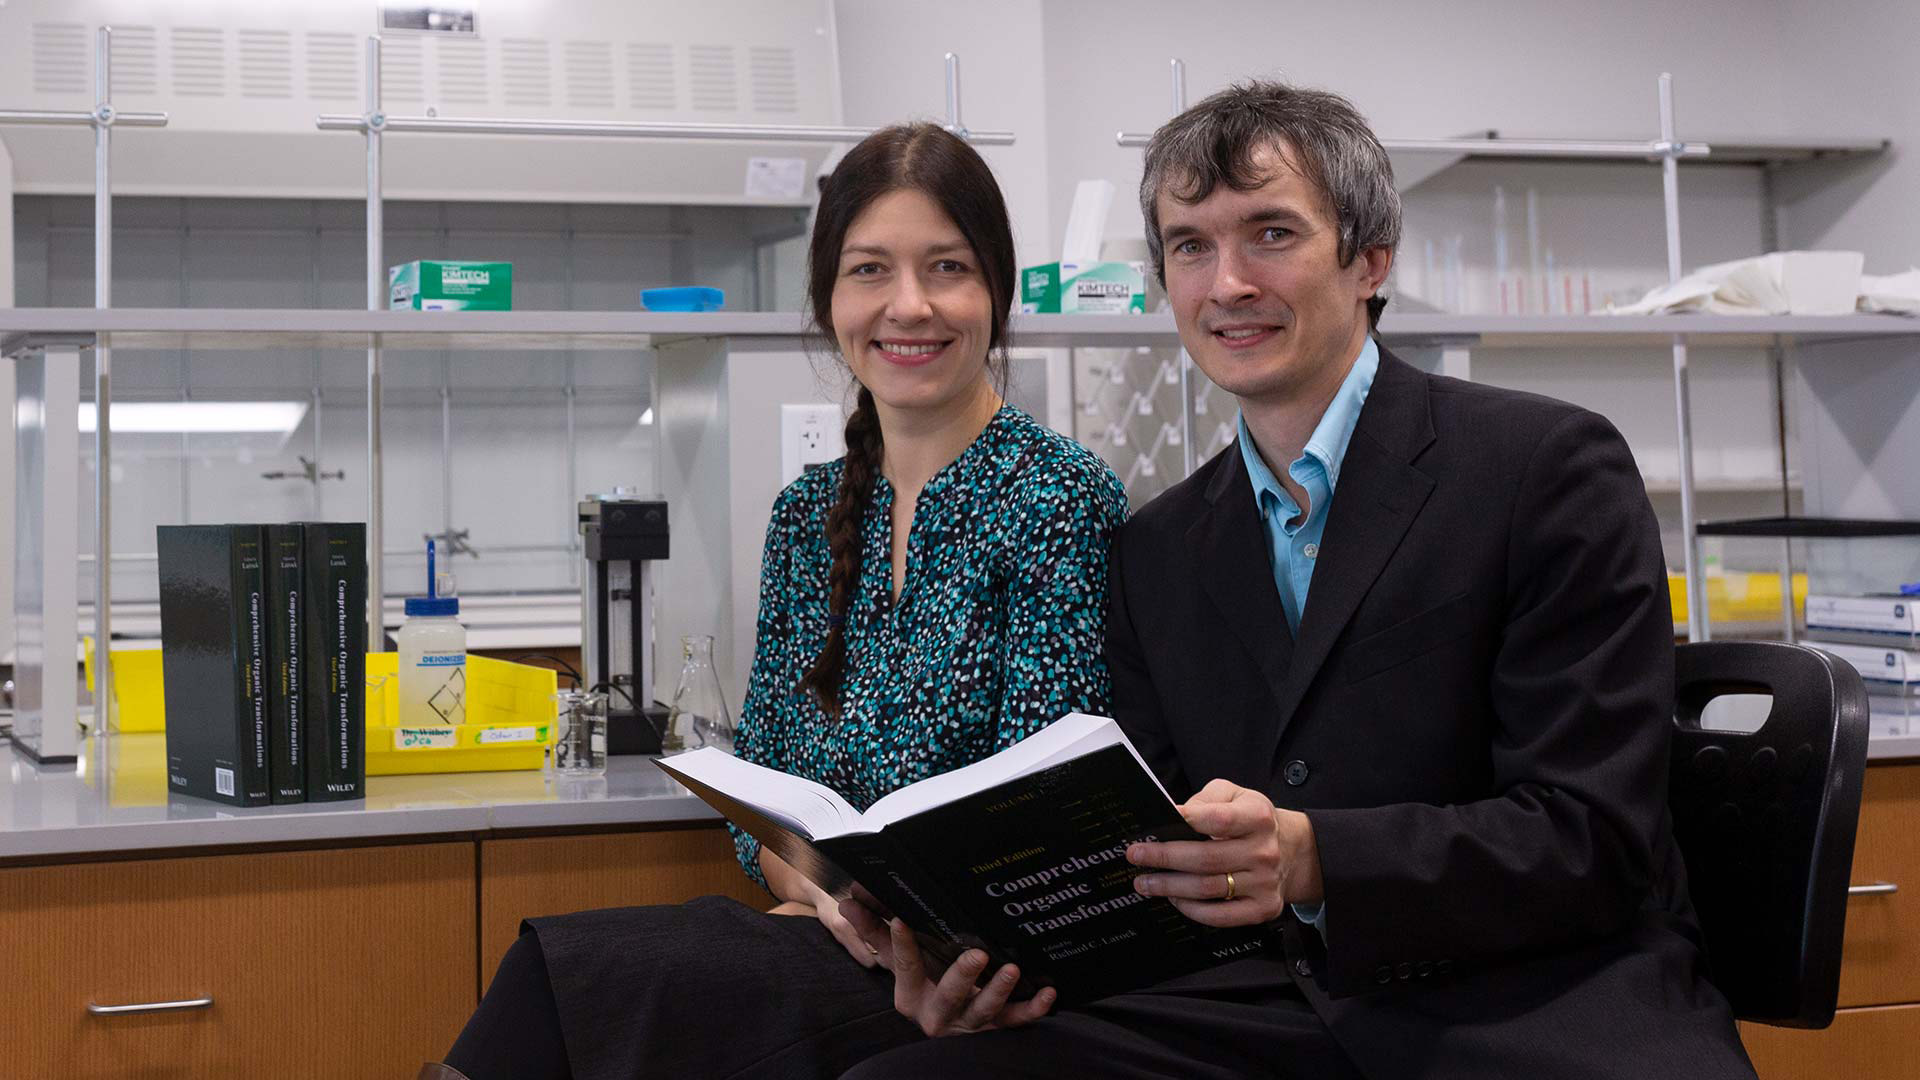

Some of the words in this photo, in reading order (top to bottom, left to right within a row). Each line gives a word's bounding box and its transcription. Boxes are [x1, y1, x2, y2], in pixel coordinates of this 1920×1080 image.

[442, 270, 490, 280] KIMTECH
[1078, 284, 1129, 294] KIMTECH
[250, 592, 260, 656] Comprehensive
[288, 591, 298, 654] Comprehensive
[337, 580, 347, 649] Comprehensive
[252, 658, 262, 693] Organic
[289, 656, 298, 691] Organic
[338, 651, 348, 689] Organic
[254, 696, 264, 768] Transformations
[290, 694, 299, 766] Transformations
[340, 692, 350, 769] Transformations
[171, 774, 187, 786] WILEY
[280, 788, 301, 796] WILEY
[327, 783, 356, 793] WILEY
[969, 857, 1001, 875] Third
[1003, 845, 1046, 865] Edition
[985, 834, 1159, 898] Comprehense
[1003, 881, 1093, 917] Organic
[1018, 891, 1152, 937] Transforma
[1048, 941, 1092, 962] Richard
[1102, 929, 1138, 946] Larock
[1211, 939, 1263, 960] WILEY
